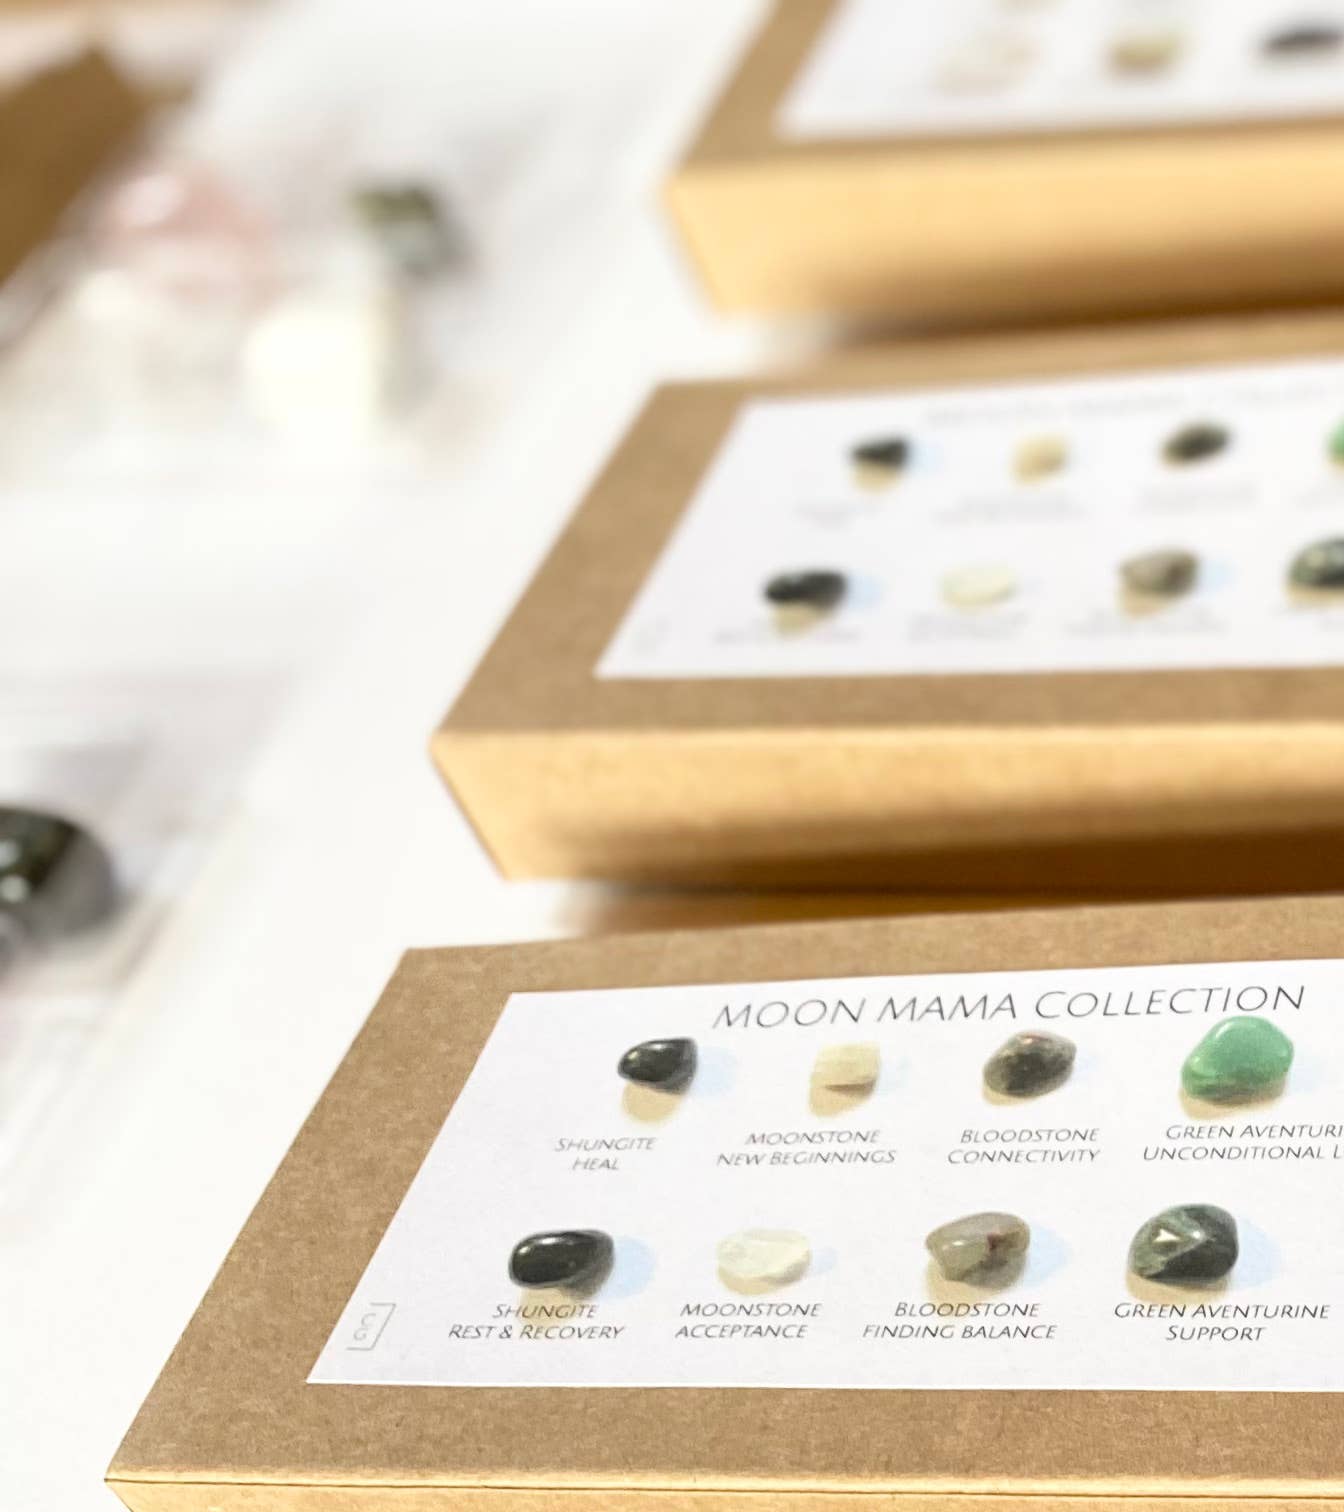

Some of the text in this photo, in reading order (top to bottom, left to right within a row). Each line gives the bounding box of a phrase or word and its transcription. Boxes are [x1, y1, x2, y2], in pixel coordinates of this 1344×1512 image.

[711, 985, 1306, 1029] MOON MAMA COLLECTION
[745, 1129, 881, 1145] MOONSTONE
[960, 1128, 1100, 1144] BLOODSTONE
[1165, 1124, 1234, 1139] GREEN
[555, 1137, 656, 1152] SHUNGITE
[717, 1150, 896, 1166] NEW BEGINNINGS
[947, 1148, 1101, 1164] CONNECTIVITY
[1143, 1145, 1325, 1161] UNCONDITIONAL
[572, 1157, 619, 1171] HEAL
[492, 1304, 600, 1319] SHUNGITE
[680, 1303, 821, 1317] MOONSTONE
[894, 1302, 1040, 1317] BLOODSTONE
[1114, 1303, 1331, 1320] GREEN AVENTURINE
[448, 1324, 625, 1340] REST & RECOVERY
[675, 1324, 808, 1339] ACCEPTANCE
[862, 1325, 1058, 1340] FINDING BALANCE
[1166, 1325, 1266, 1341] SUPPORT
